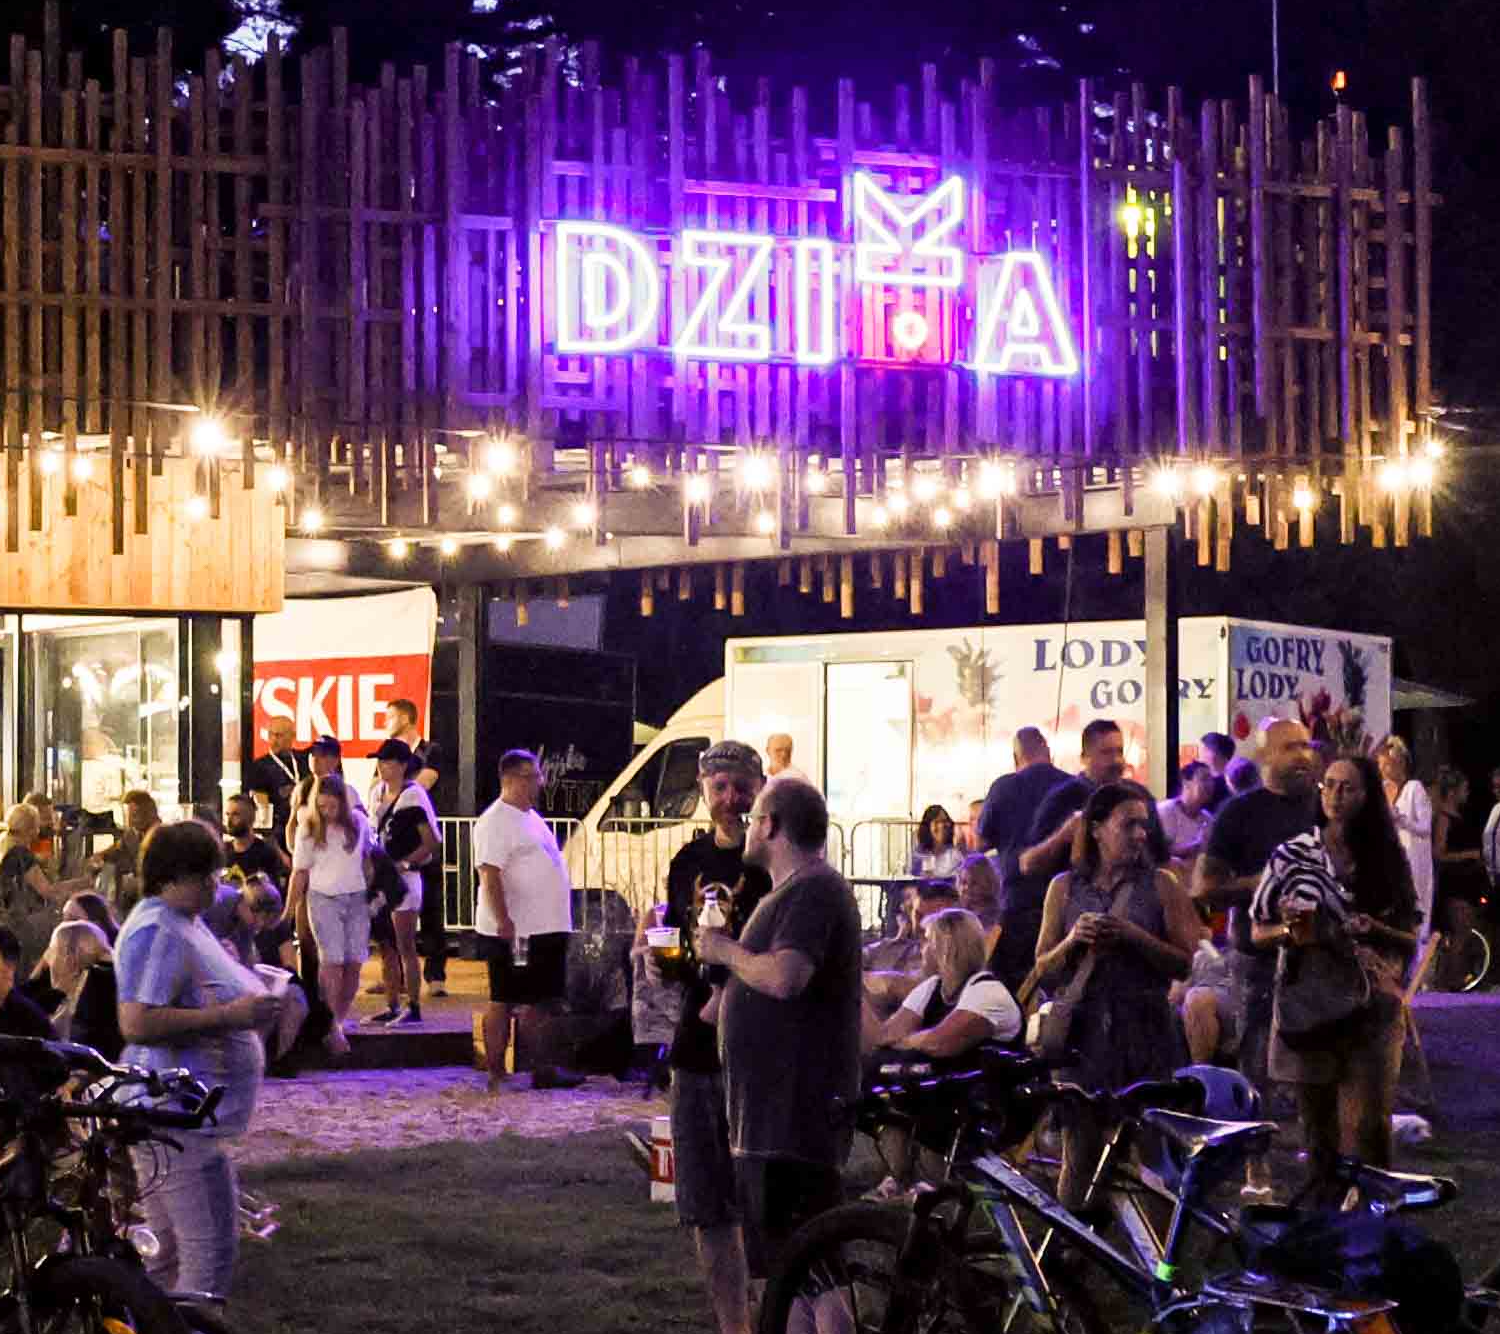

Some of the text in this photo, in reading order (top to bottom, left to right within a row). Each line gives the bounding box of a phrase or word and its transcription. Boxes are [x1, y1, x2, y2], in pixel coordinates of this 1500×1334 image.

[1246, 635, 1326, 676] GOFRY
[1090, 677, 1216, 709] GORY
[1236, 669, 1301, 700] LODY
